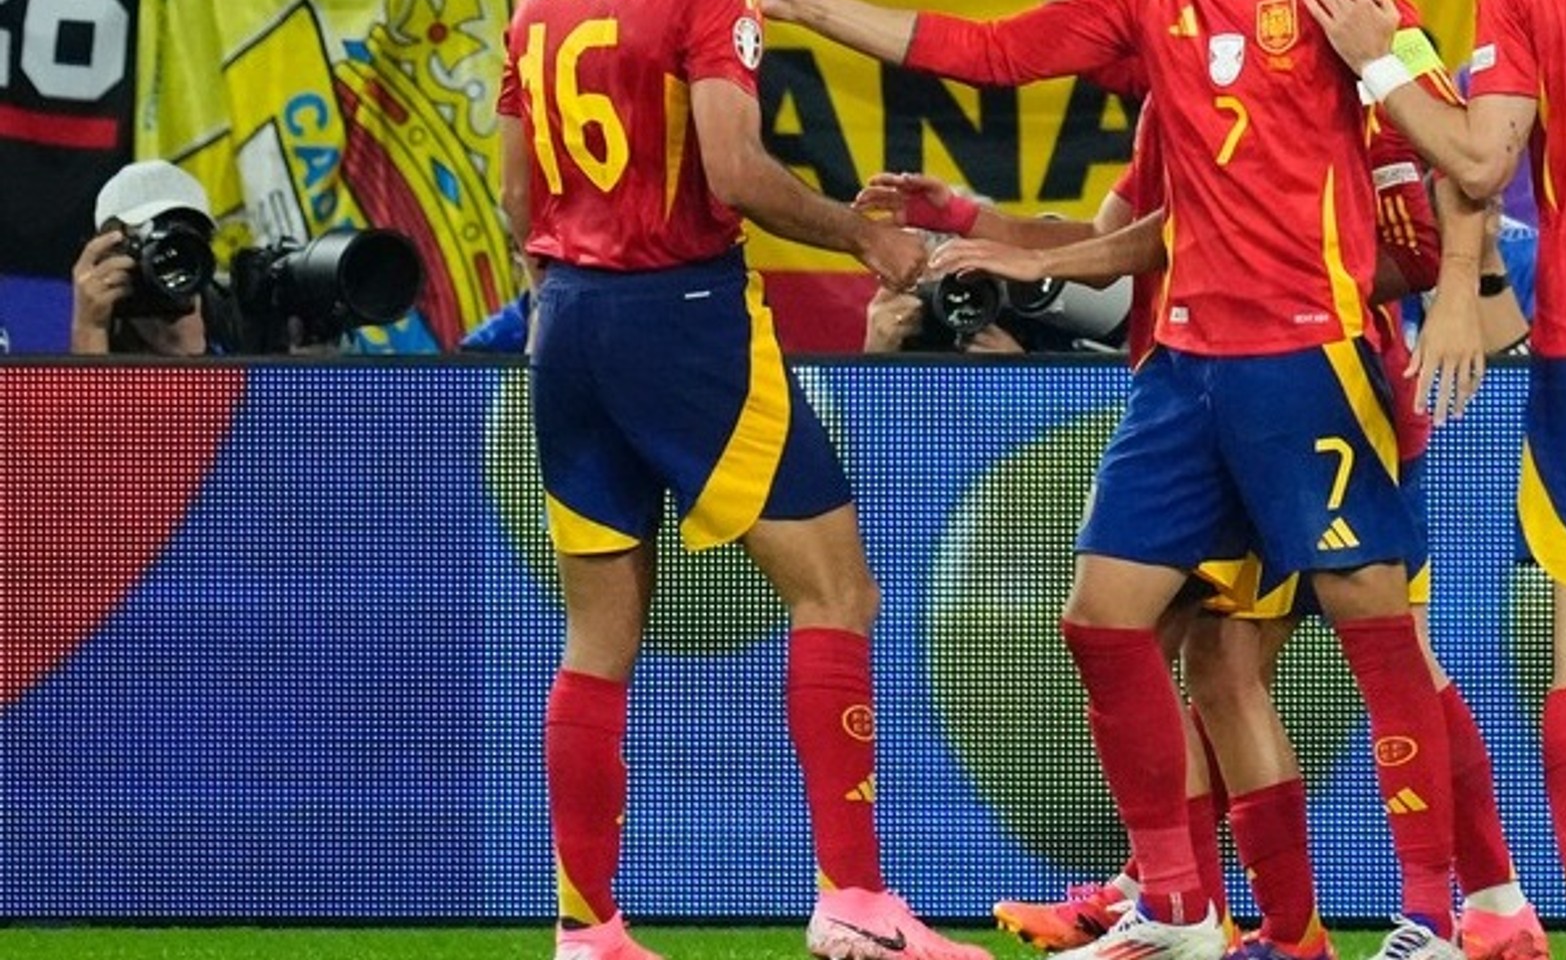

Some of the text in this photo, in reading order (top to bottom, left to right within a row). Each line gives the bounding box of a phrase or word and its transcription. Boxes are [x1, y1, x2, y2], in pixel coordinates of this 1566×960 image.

[517, 18, 630, 196] 16
[1214, 95, 1249, 166] 7
[1314, 436, 1355, 511] 7
